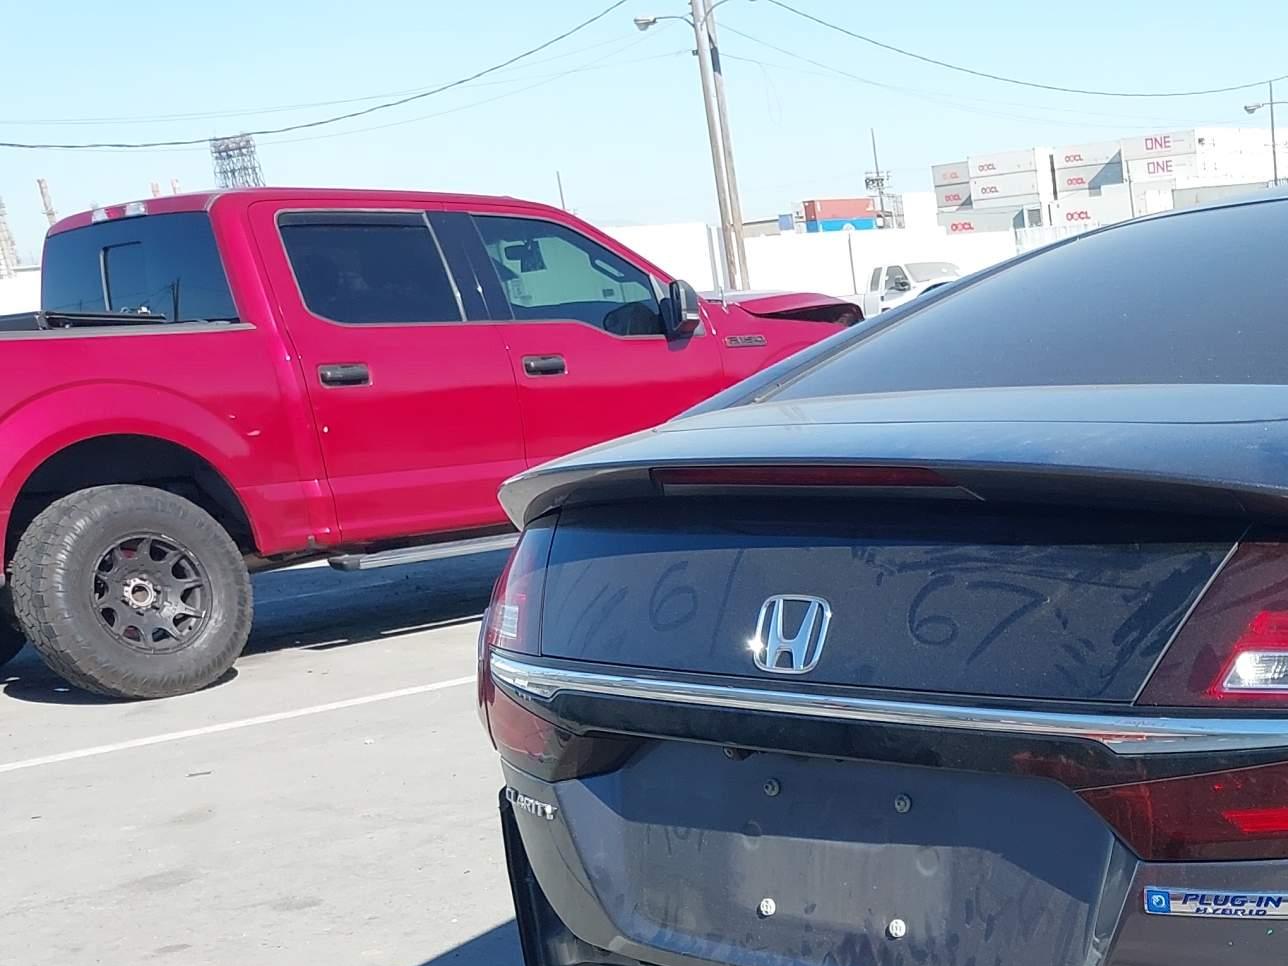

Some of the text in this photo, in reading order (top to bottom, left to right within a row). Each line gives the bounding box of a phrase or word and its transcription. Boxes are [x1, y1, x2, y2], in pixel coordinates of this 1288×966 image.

[1145, 135, 1171, 150] ONE
[1064, 154, 1084, 163] OOCL
[978, 163, 997, 172] OOCL
[1147, 160, 1173, 174] ONE
[1066, 177, 1086, 186] OOCL
[980, 186, 999, 195] OOCL
[1066, 211, 1091, 221] OOCL
[951, 222, 975, 231] OOCL
[1182, 893, 1283, 908] PLUG-IN
[1195, 907, 1267, 917] HYBRID
